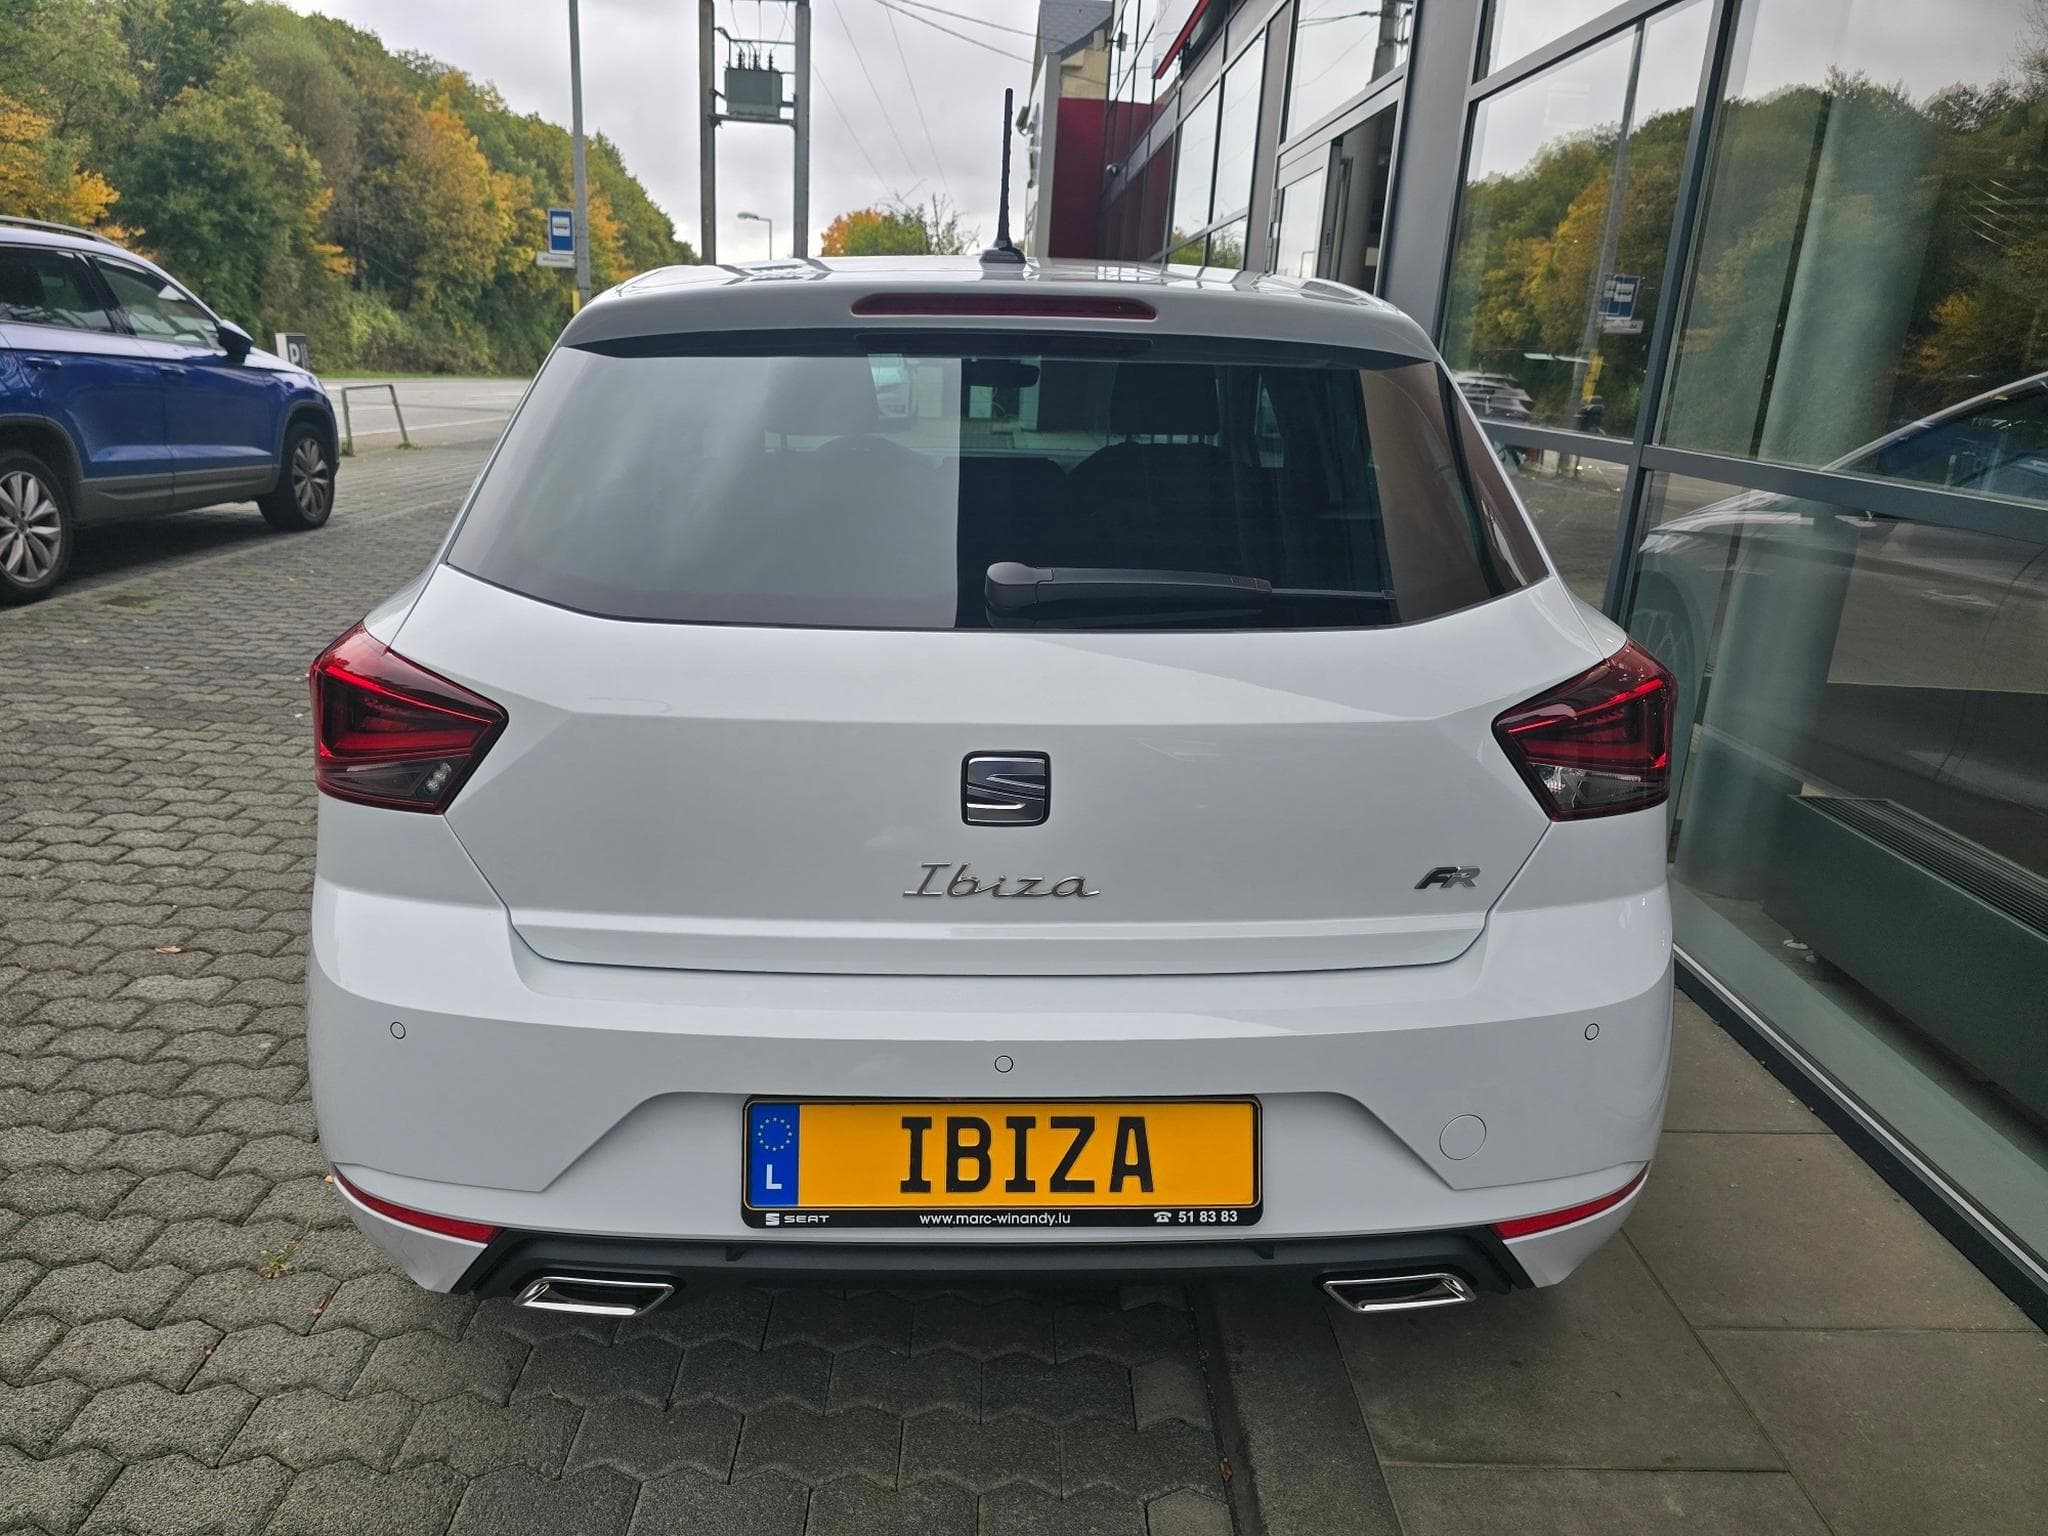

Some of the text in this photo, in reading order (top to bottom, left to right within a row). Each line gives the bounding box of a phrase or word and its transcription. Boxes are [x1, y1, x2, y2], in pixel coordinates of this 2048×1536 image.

[902, 862, 1100, 898] Ibiza
[1414, 865, 1481, 889] FR
[900, 1116, 1155, 1193] IBIZA
[765, 1163, 783, 1190] L
[783, 1214, 830, 1224] SEAT
[919, 1212, 1071, 1226] www.marc-winandy.lu
[1178, 1210, 1238, 1223] 51 83 83
